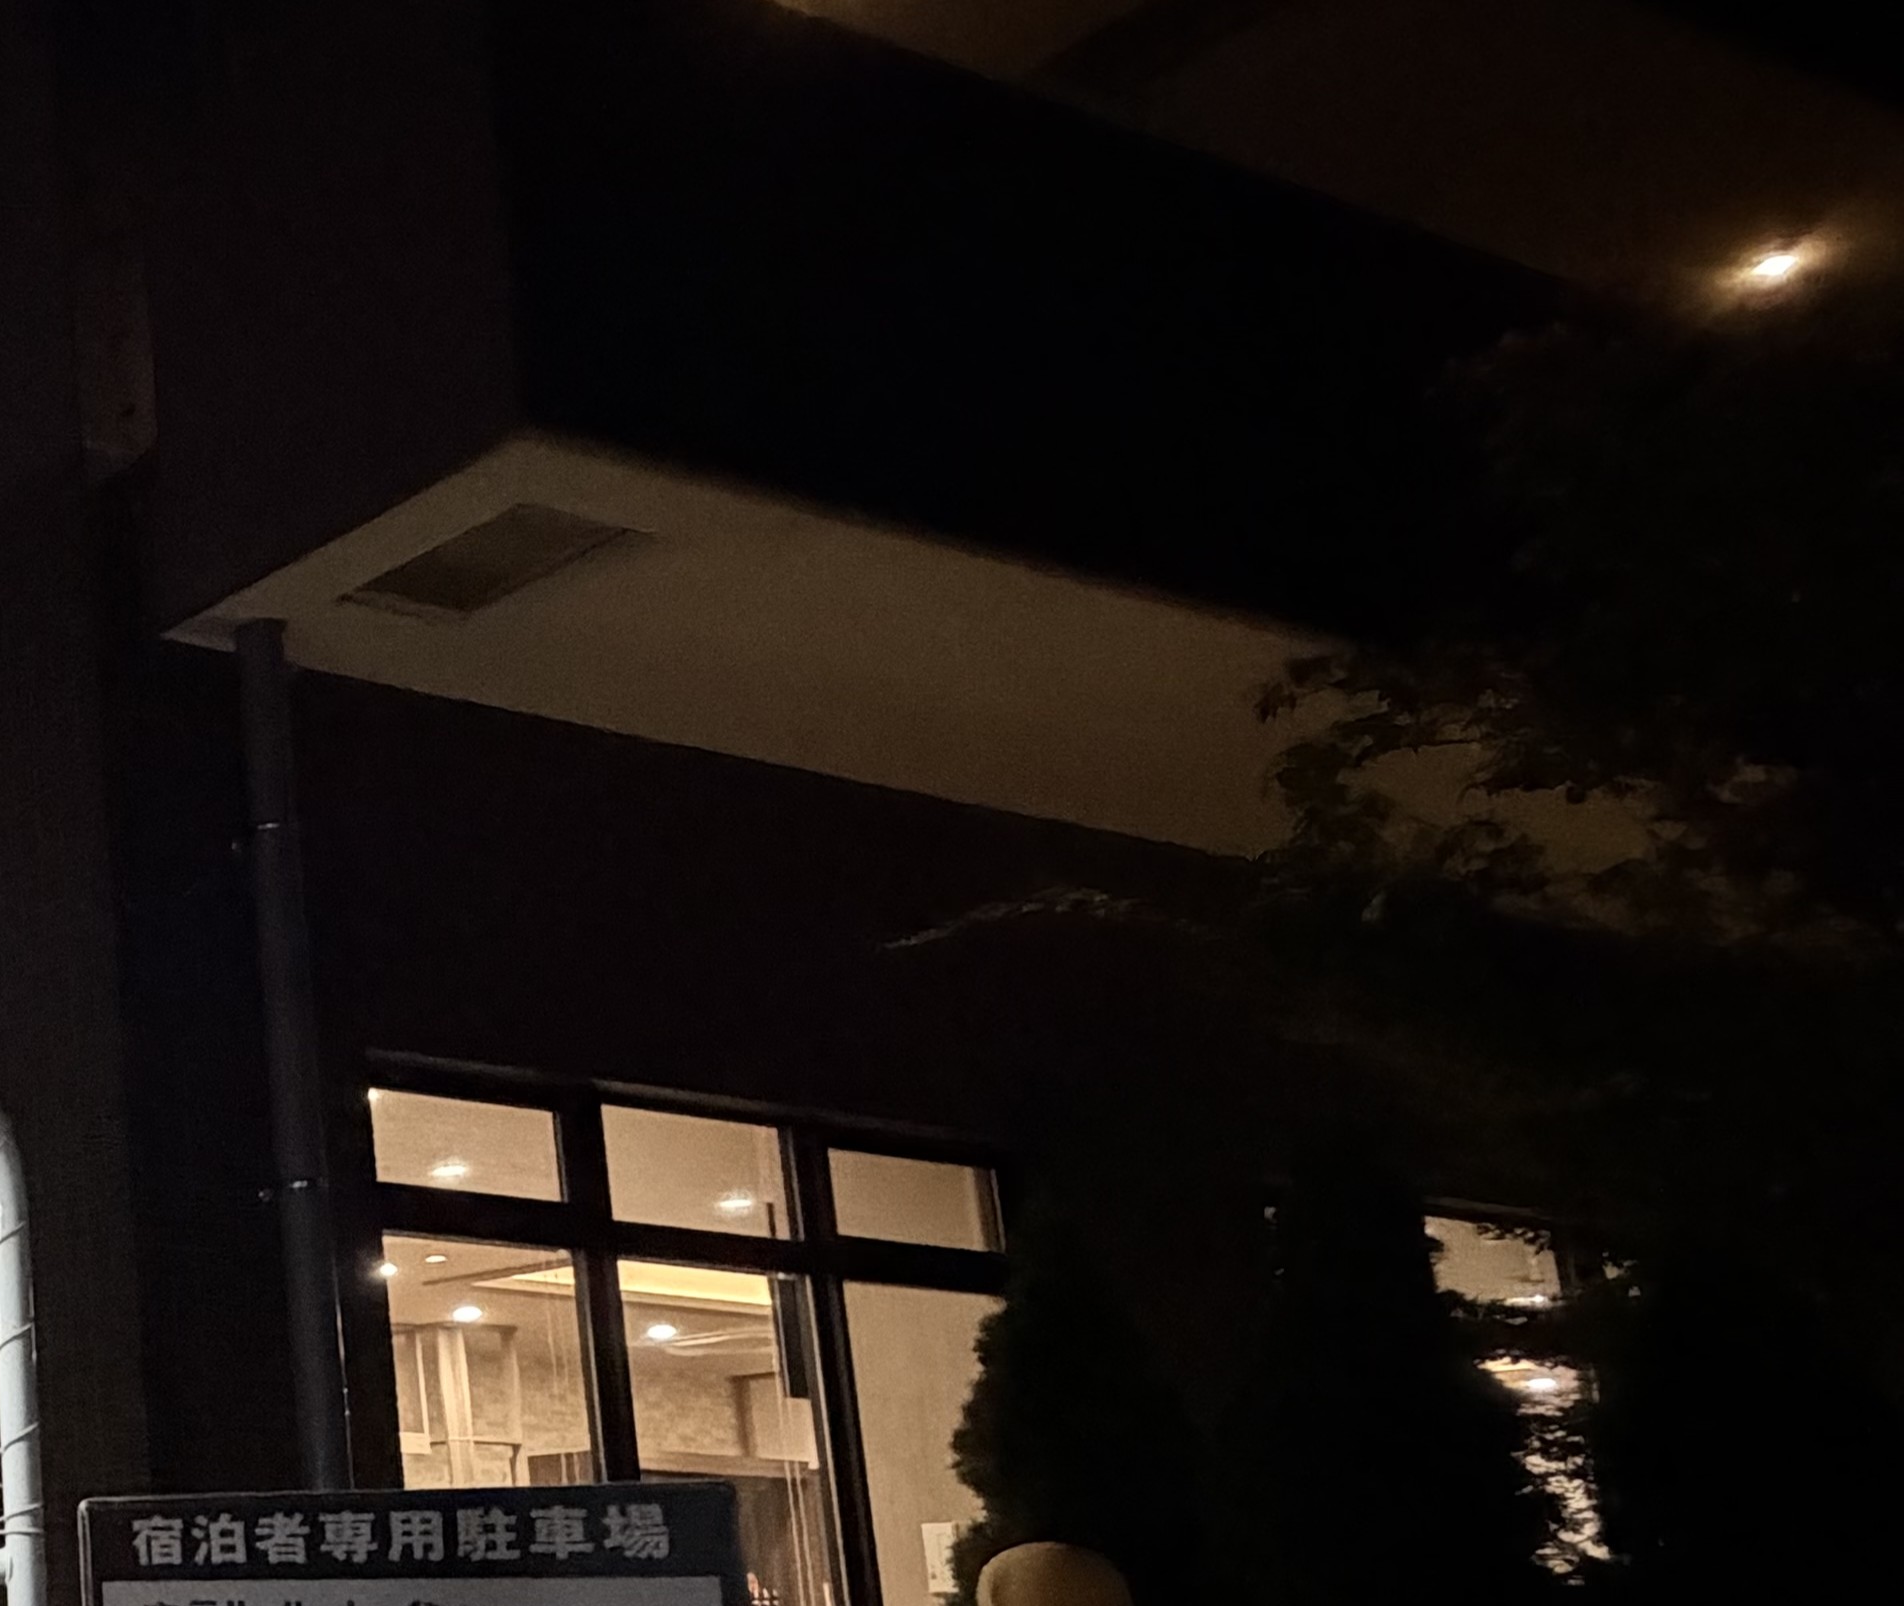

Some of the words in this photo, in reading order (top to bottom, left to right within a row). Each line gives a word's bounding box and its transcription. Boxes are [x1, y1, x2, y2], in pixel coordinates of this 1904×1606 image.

[132, 1504, 671, 1566] 宿泊者専用駐車場
